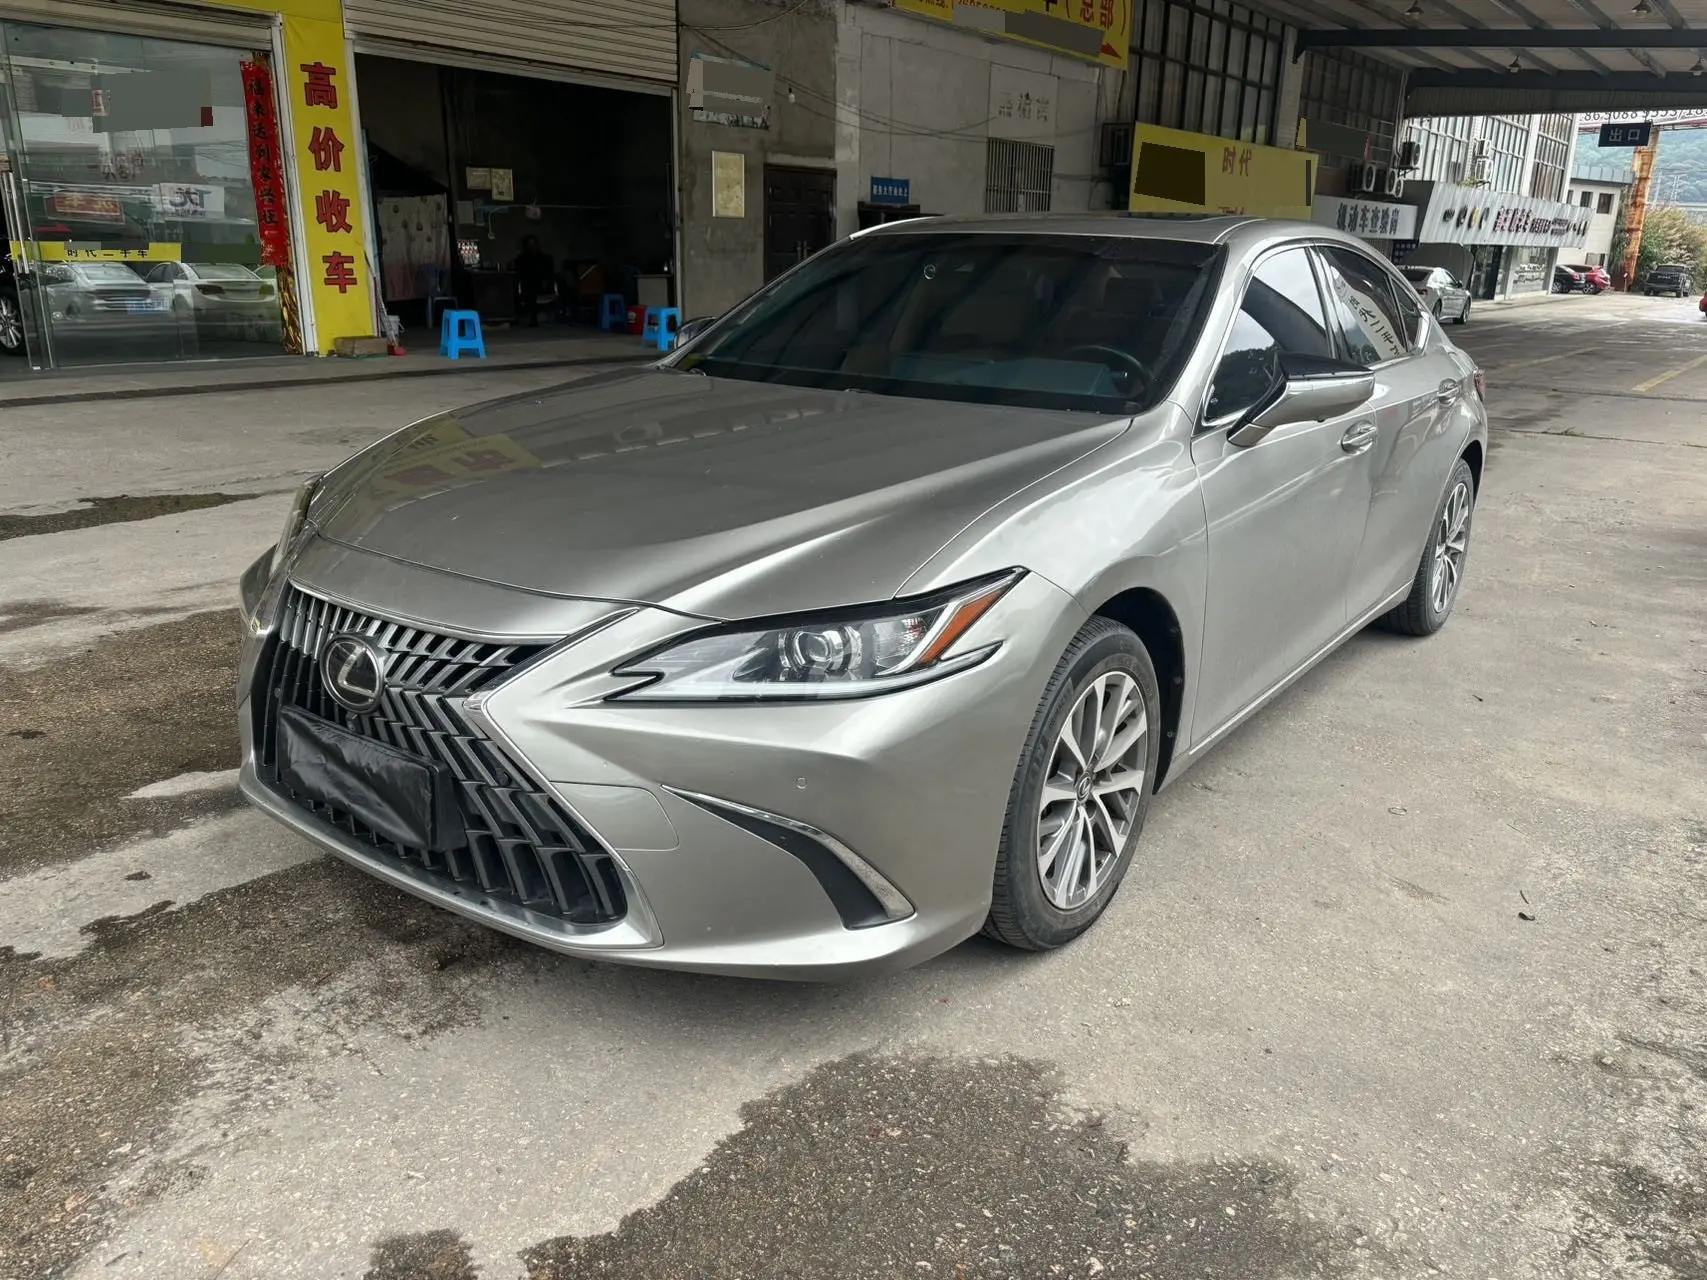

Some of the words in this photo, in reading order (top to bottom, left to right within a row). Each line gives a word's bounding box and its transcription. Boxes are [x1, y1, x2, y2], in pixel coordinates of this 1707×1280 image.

[1608, 127, 1640, 142] 出口
[1222, 145, 1252, 177] 时代
[300, 61, 358, 294] 高价收车
